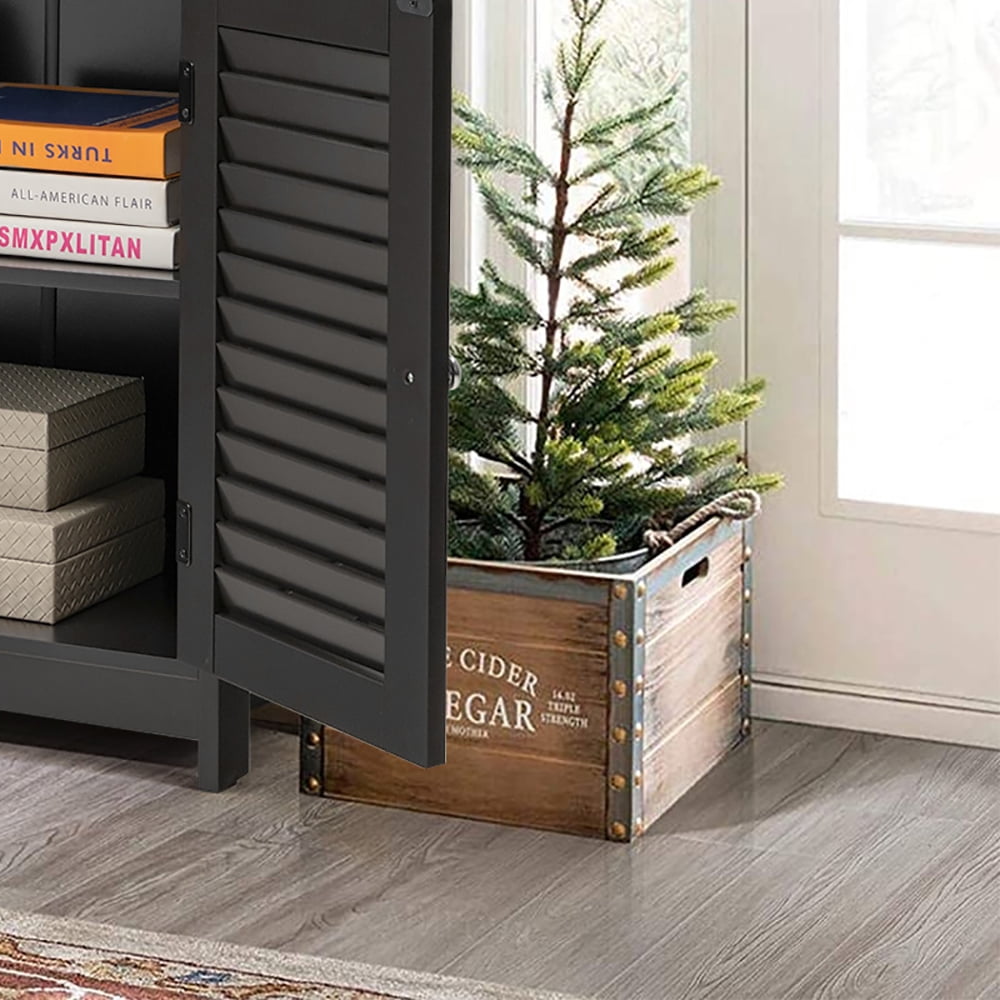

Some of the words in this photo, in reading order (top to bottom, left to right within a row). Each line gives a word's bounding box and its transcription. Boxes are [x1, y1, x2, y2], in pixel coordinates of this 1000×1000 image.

[12, 140, 34, 157] IN
[44, 143, 113, 163] TURKS
[10, 187, 110, 207] ALL-AMERICAN
[114, 195, 153, 210] FLAIR
[459, 647, 539, 698] CIDER
